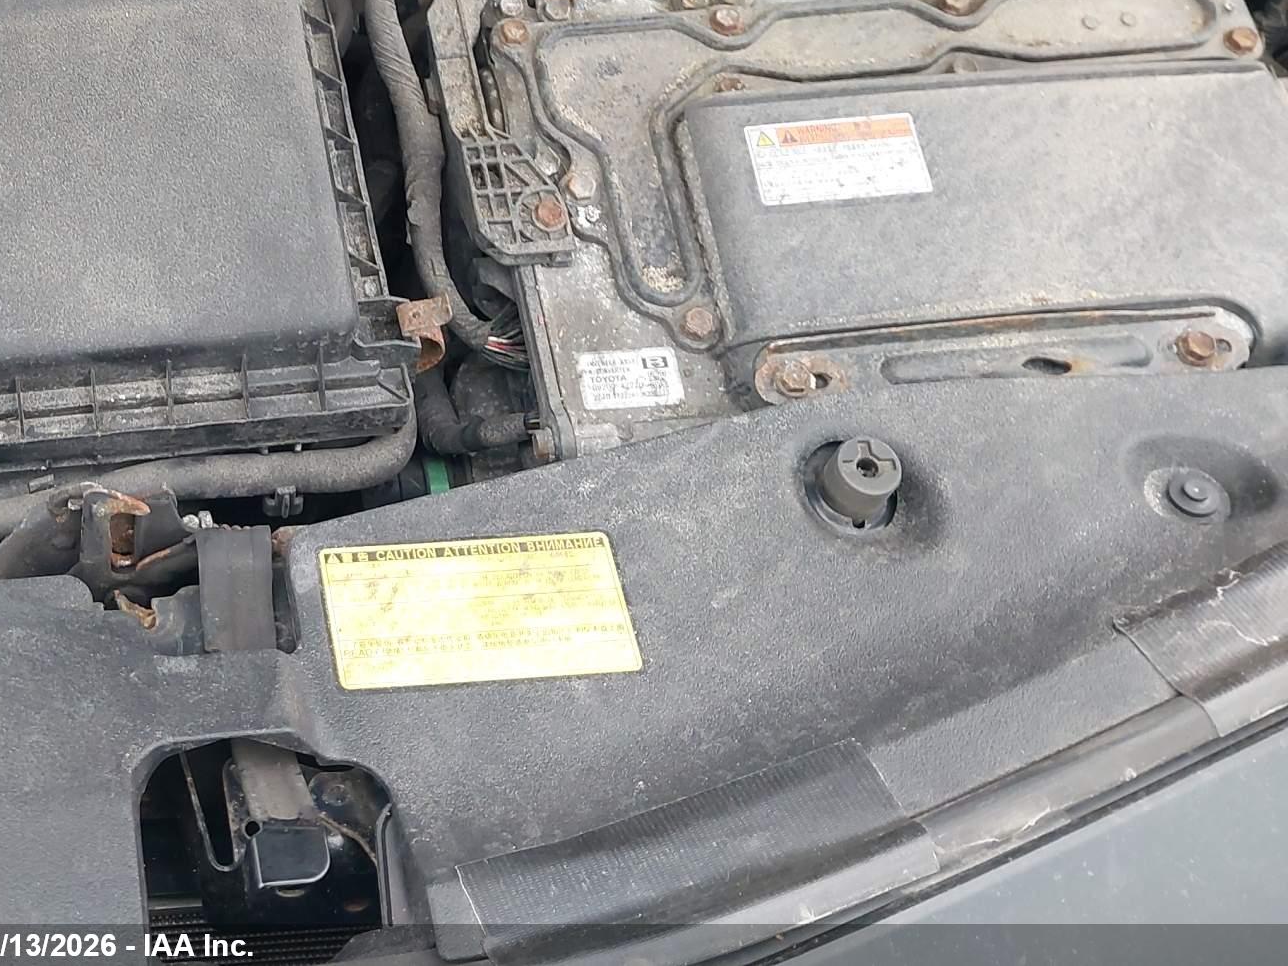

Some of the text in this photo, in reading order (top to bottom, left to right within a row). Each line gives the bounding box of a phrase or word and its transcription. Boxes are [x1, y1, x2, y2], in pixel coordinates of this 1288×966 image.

[589, 374, 627, 383] TOYOTA
[376, 547, 435, 560] CAUTION
[445, 542, 521, 557] ATTENTION
[527, 537, 604, 552] ВНИМАНИЕ
